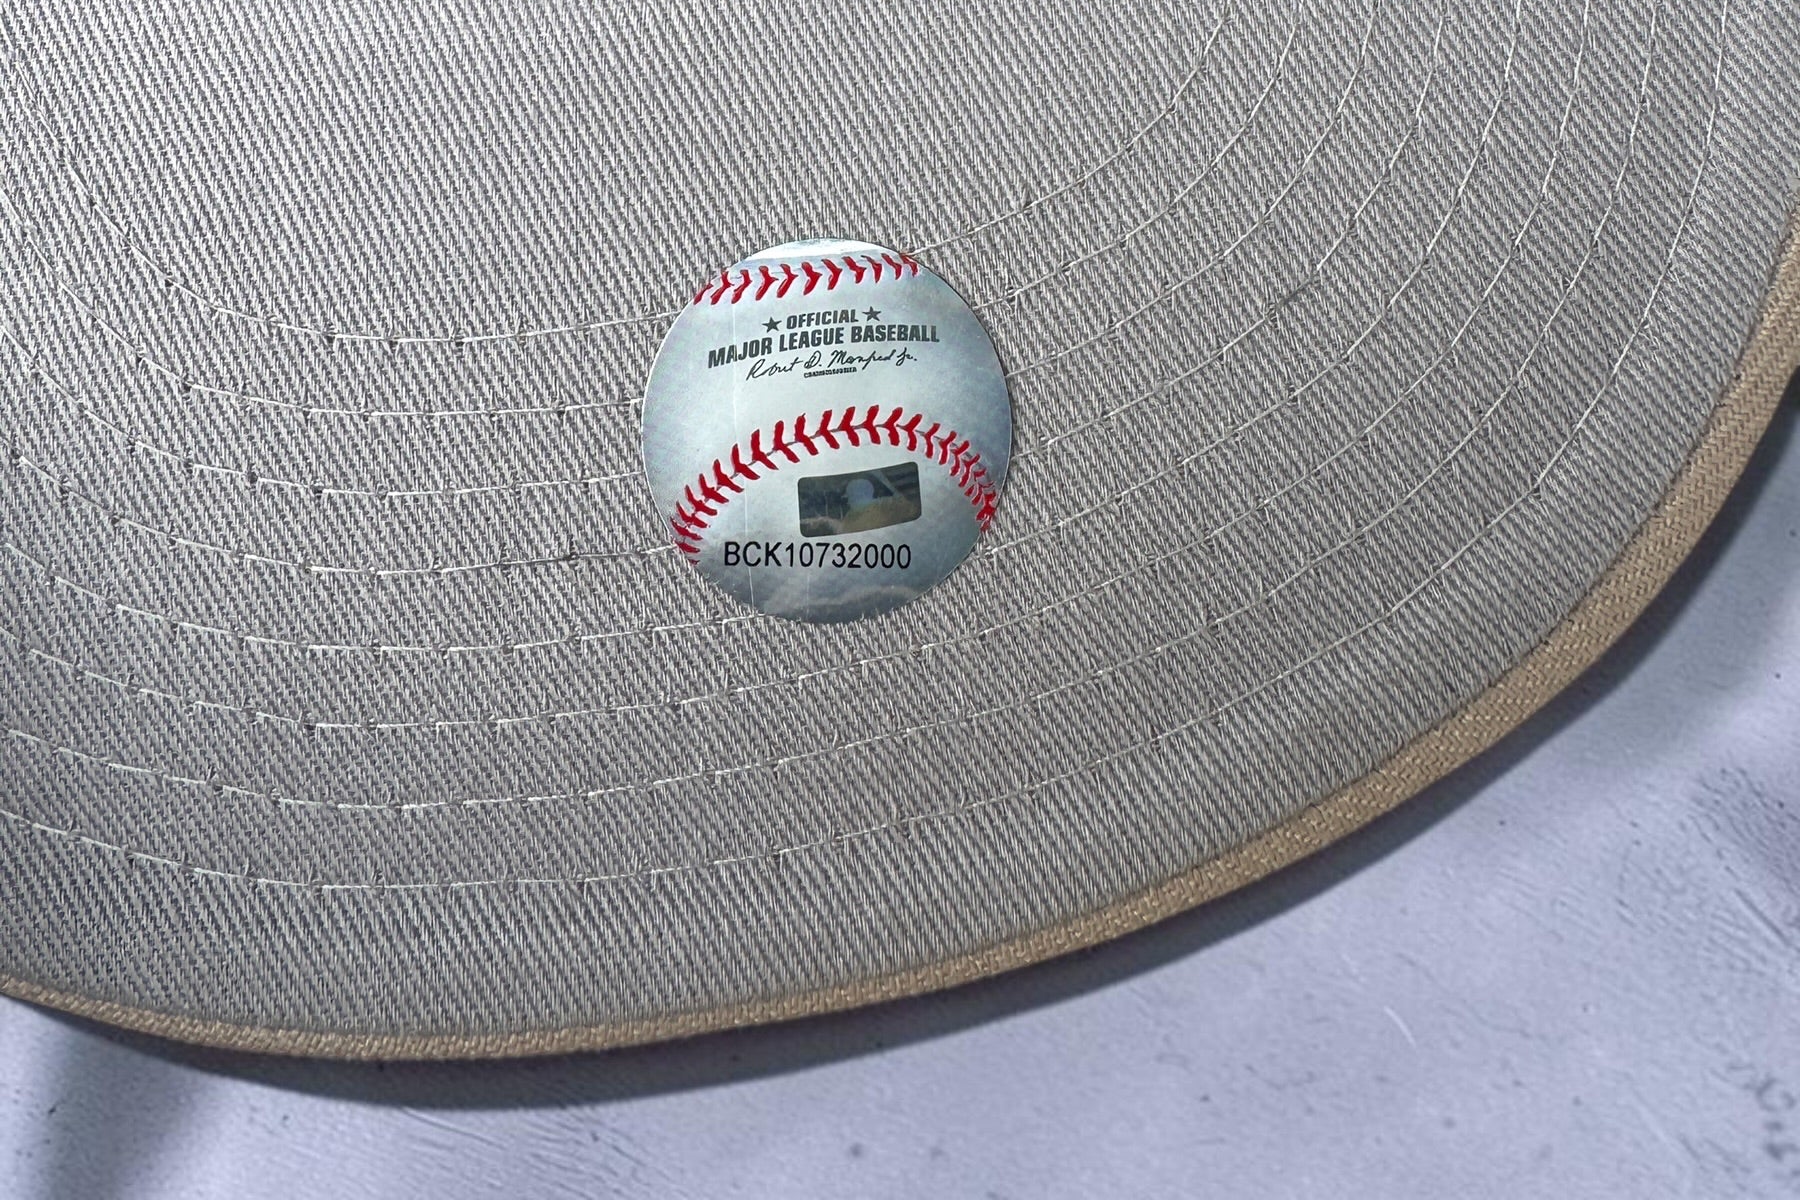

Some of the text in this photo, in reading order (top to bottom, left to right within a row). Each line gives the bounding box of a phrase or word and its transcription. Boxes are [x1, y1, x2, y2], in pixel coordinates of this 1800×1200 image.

[786, 309, 859, 329] OFFICIAL
[708, 324, 940, 368] MAJOR LEAGUE BASEBALL
[724, 541, 912, 569] BCK10732000
